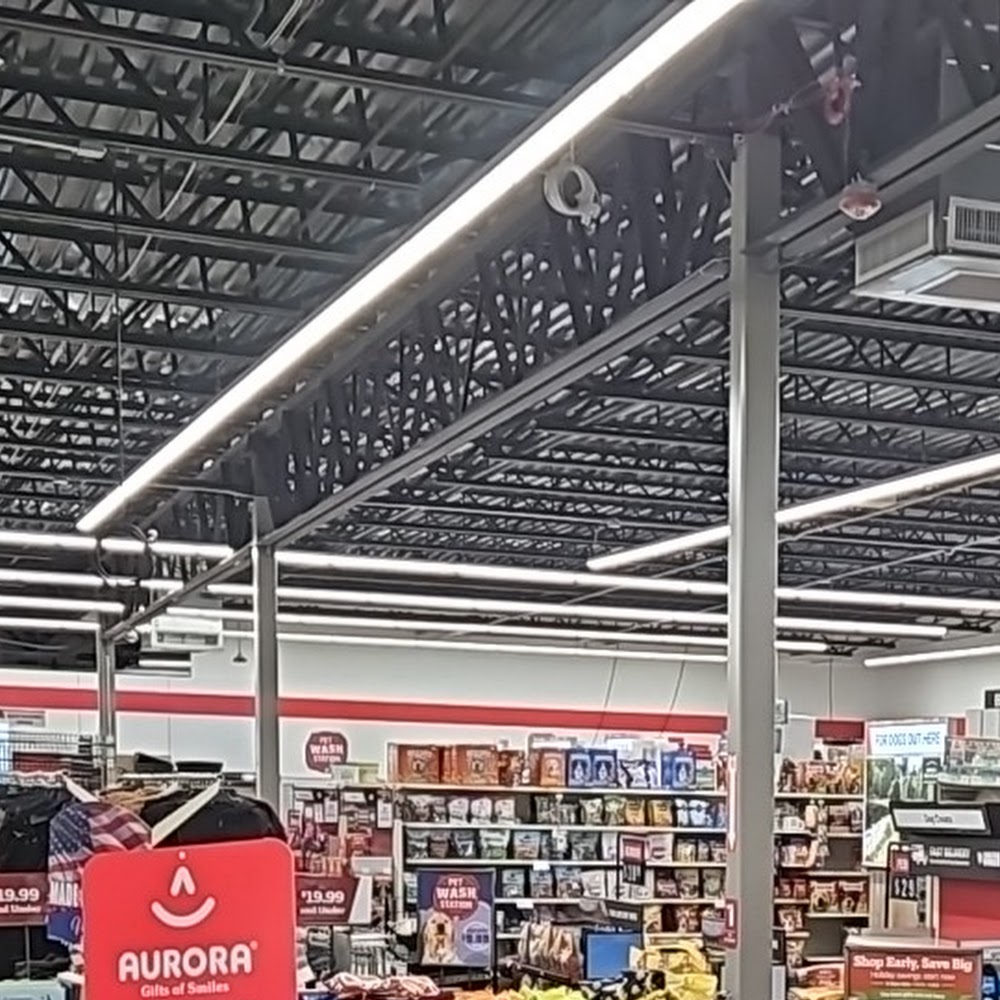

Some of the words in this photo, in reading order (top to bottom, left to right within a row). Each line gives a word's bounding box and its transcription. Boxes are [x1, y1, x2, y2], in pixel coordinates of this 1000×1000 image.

[908, 732, 922, 746] OUT
[310, 744, 344, 755] WASH
[436, 887, 477, 899] WASH
[119, 943, 253, 982] AURORA
[853, 955, 884, 970] Shop
[886, 956, 920, 971] Early,
[922, 957, 950, 970] Save
[952, 958, 973, 973] Big
[141, 984, 170, 998] Gifts
[172, 981, 185, 995] of
[187, 980, 229, 994] Smiles
